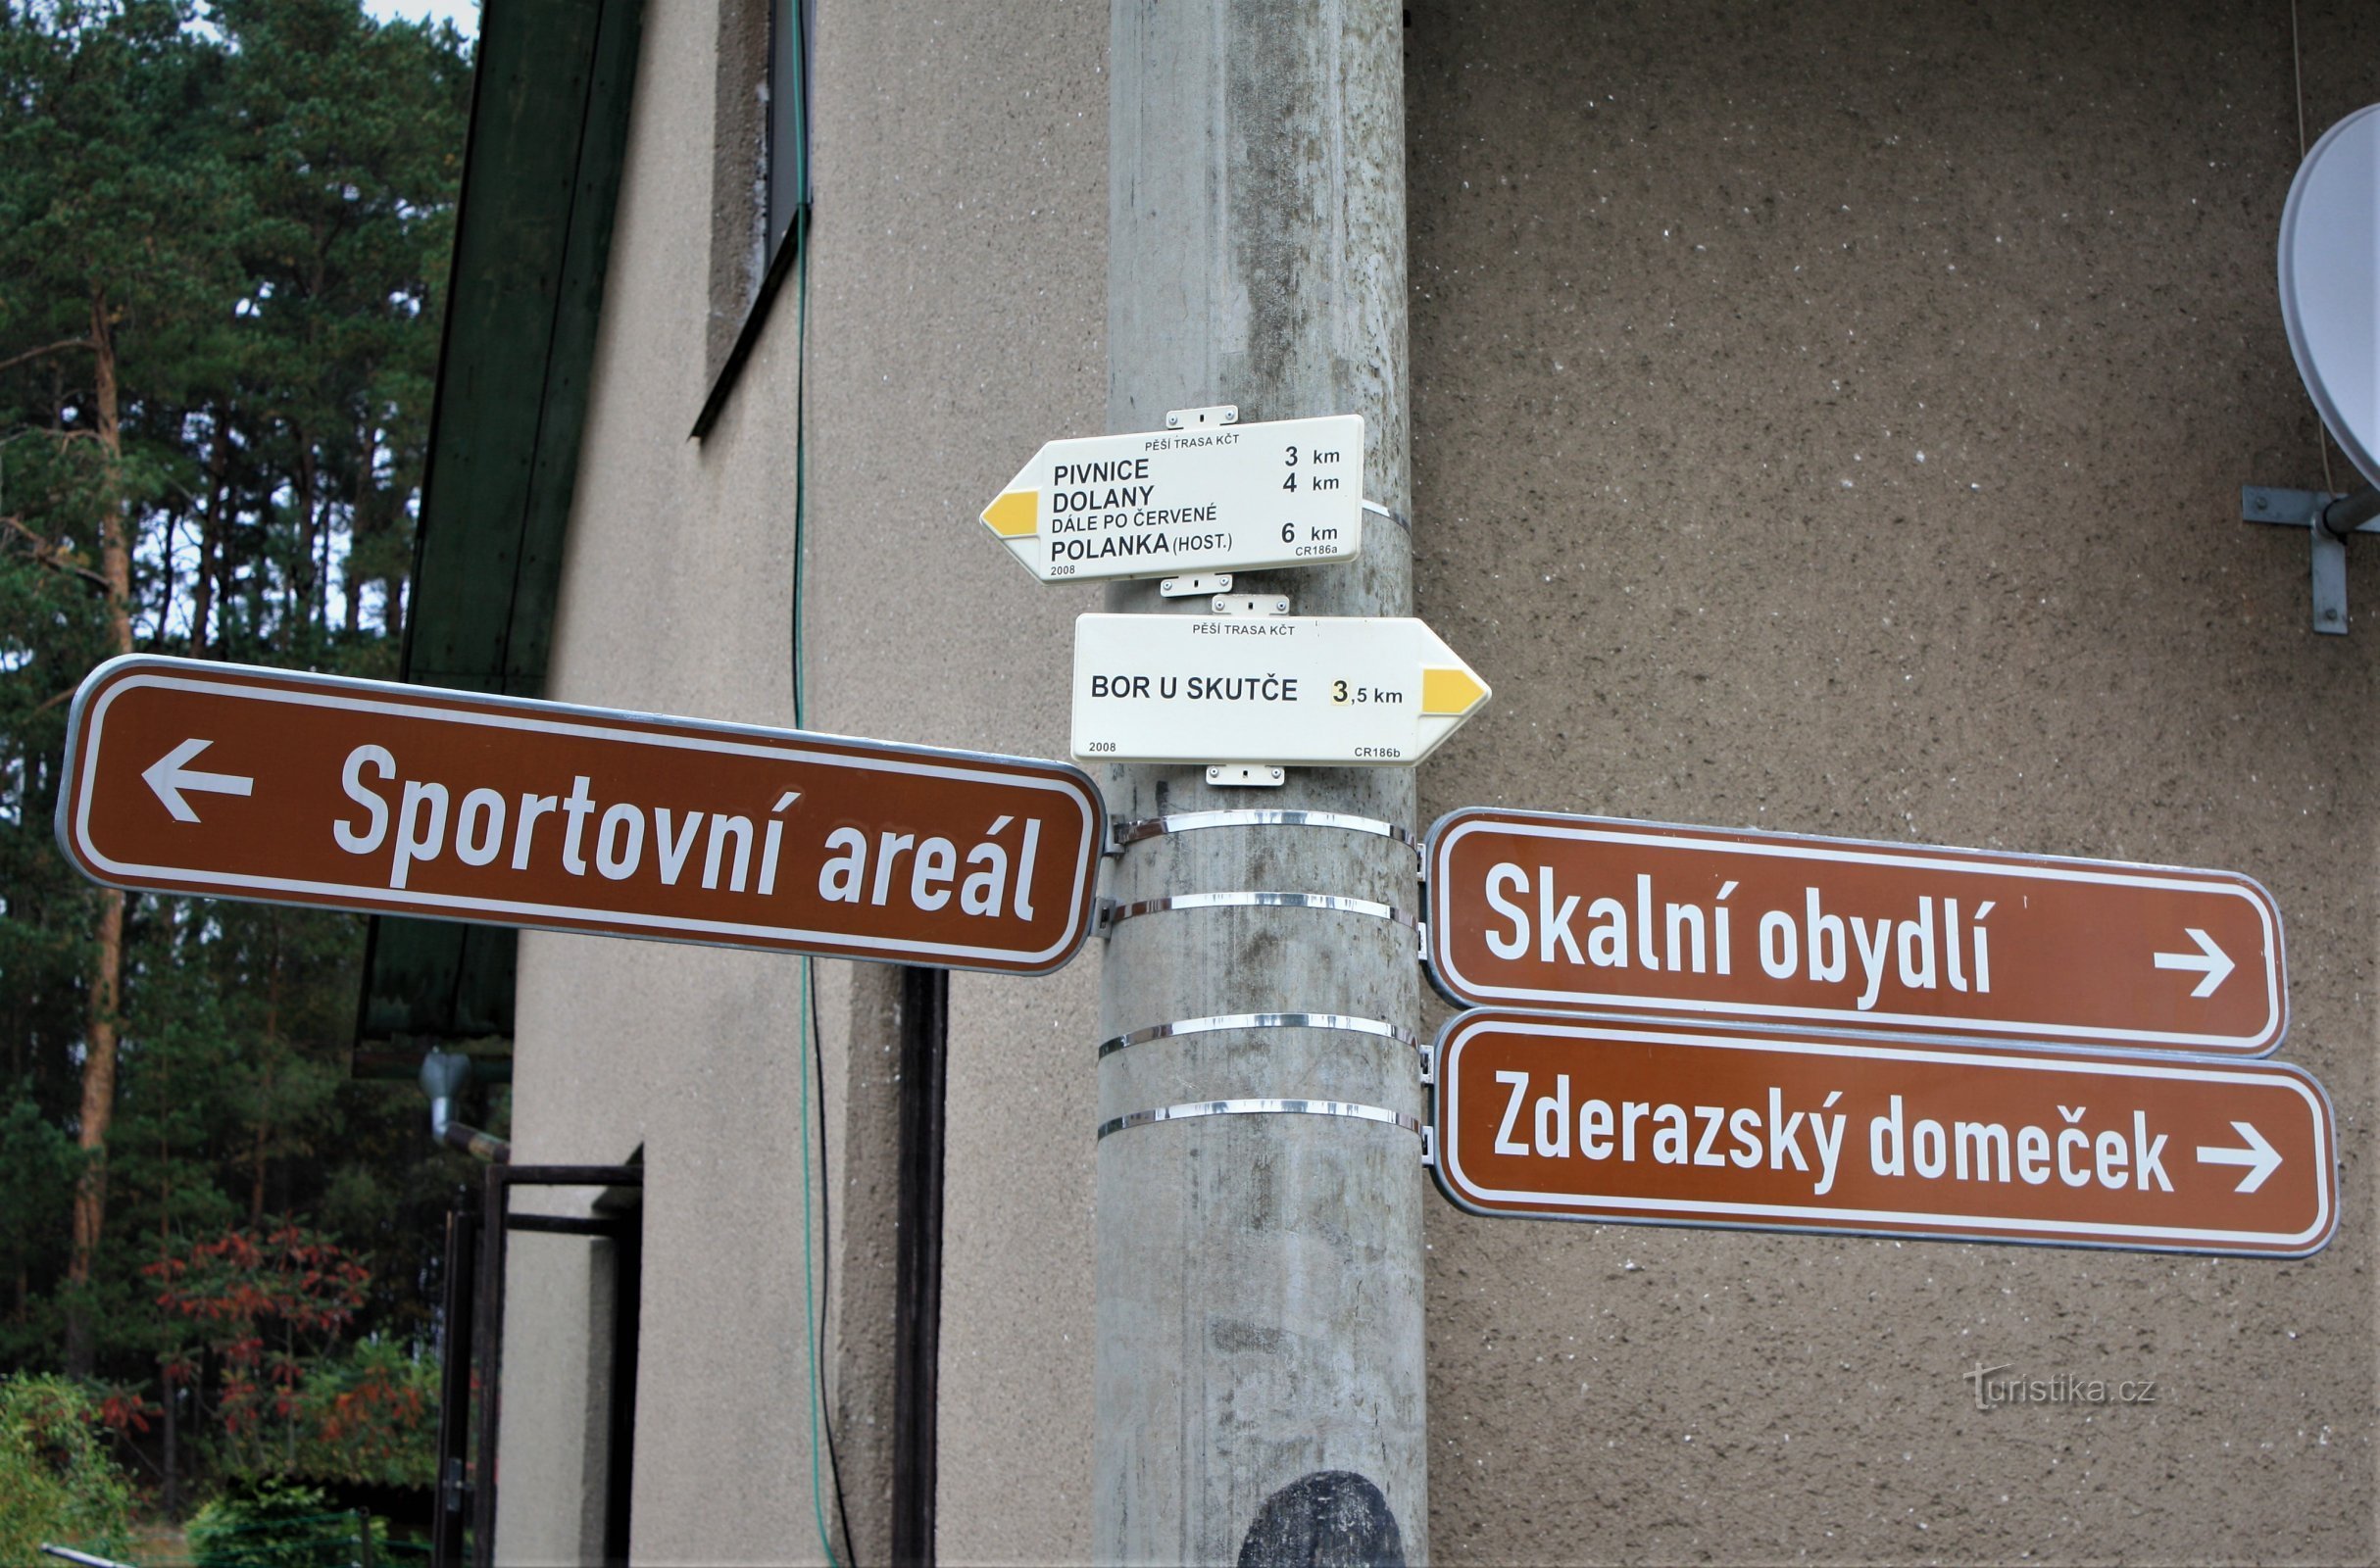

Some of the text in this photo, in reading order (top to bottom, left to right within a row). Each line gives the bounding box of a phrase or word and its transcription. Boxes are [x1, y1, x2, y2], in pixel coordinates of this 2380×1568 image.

[1145, 433, 1240, 452] PĚŠÍ TRASA KČT
[1053, 446, 1340, 486] PIVNICE 3 km
[1053, 472, 1340, 514] DOLANY 4 km
[1052, 502, 1217, 534] DÁLE PO ČERVENÉ
[1051, 522, 1338, 562] POLANKA (HOST.) 6 km
[1295, 545, 1338, 557] CR186a
[1051, 564, 1075, 576] 2008
[1193, 623, 1295, 636] PĚŠÍ TRASA KČT
[1091, 673, 1403, 705] BOR U SKUTČE 3,5 km
[1089, 742, 1116, 753] 2008
[1354, 747, 1401, 759] CR186b
[332, 742, 1041, 923] Sportovní areál
[1483, 861, 1997, 1010] Skalní obydlí
[1493, 1070, 2175, 1196] Zderazský domeček
